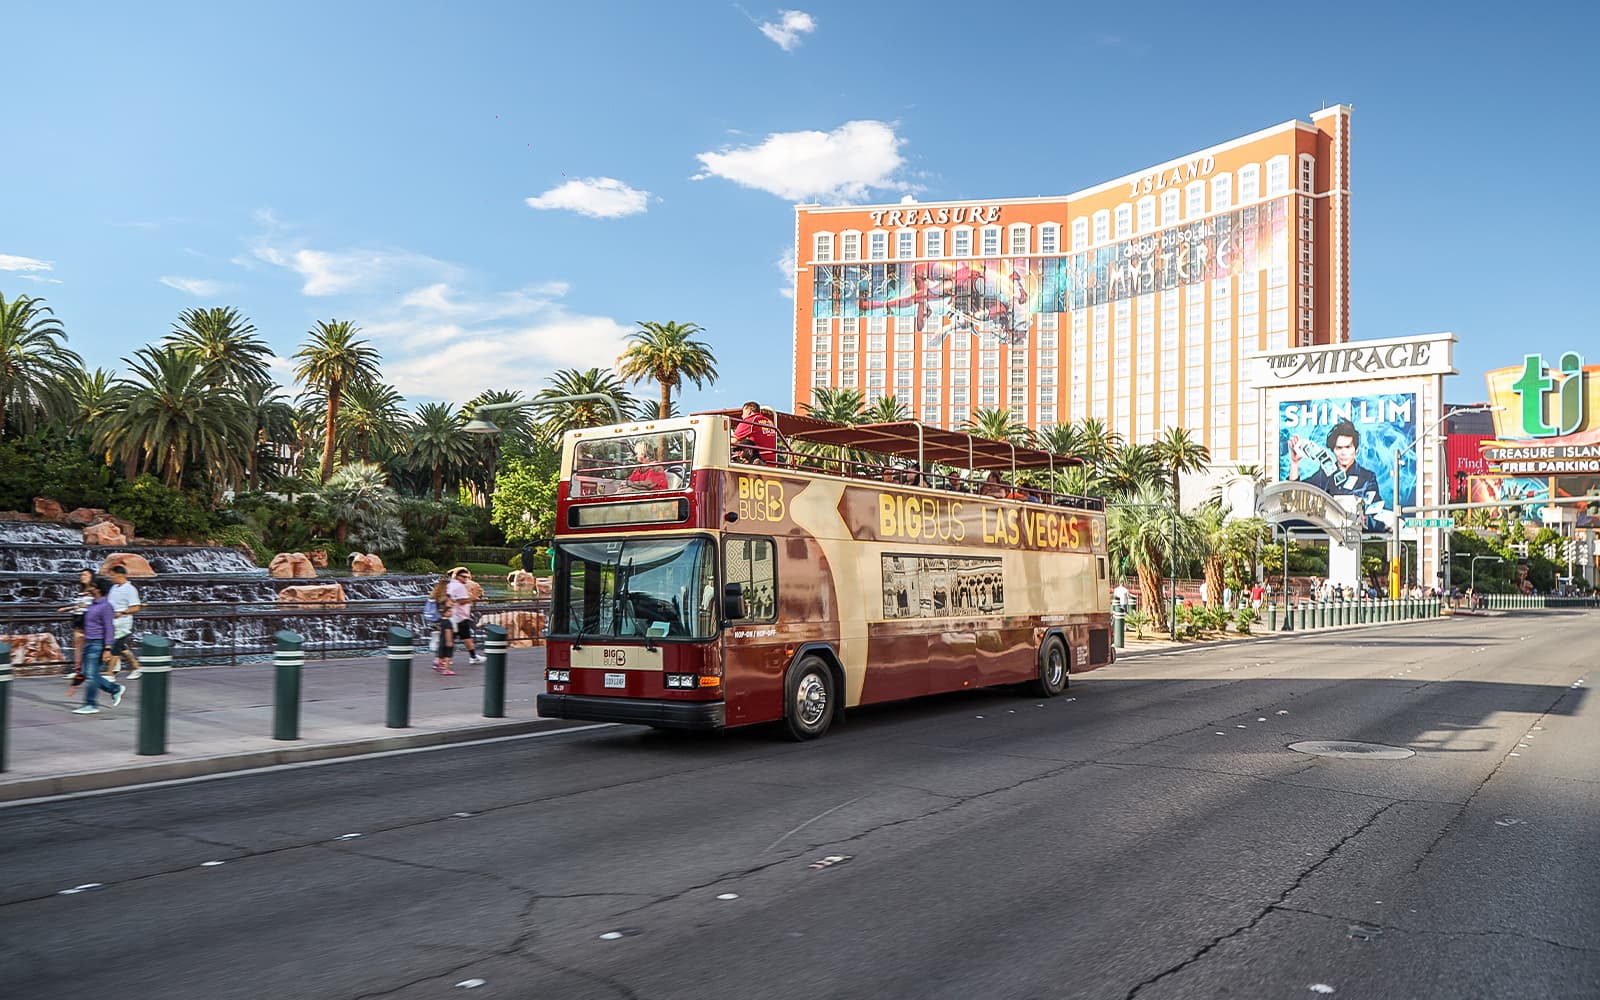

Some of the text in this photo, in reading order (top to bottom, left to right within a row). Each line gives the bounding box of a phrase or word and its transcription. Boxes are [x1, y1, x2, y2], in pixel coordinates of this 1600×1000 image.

[870, 154, 1216, 227] TREASURE ISLAND
[1161, 233, 1177, 249] DU
[1267, 341, 1431, 379] THE MIRAGE
[1285, 399, 1411, 428] SHIN LIM
[1457, 457, 1483, 469] Find
[1491, 448, 1555, 459] TREASURE
[1502, 462, 1535, 473] FREE
[1538, 461, 1600, 472] PARKING
[739, 476, 765, 500] BIG
[740, 500, 766, 521] BUS
[981, 505, 1020, 545] LAS
[1023, 510, 1081, 549] VEGAS
[603, 649, 616, 658] BIG
